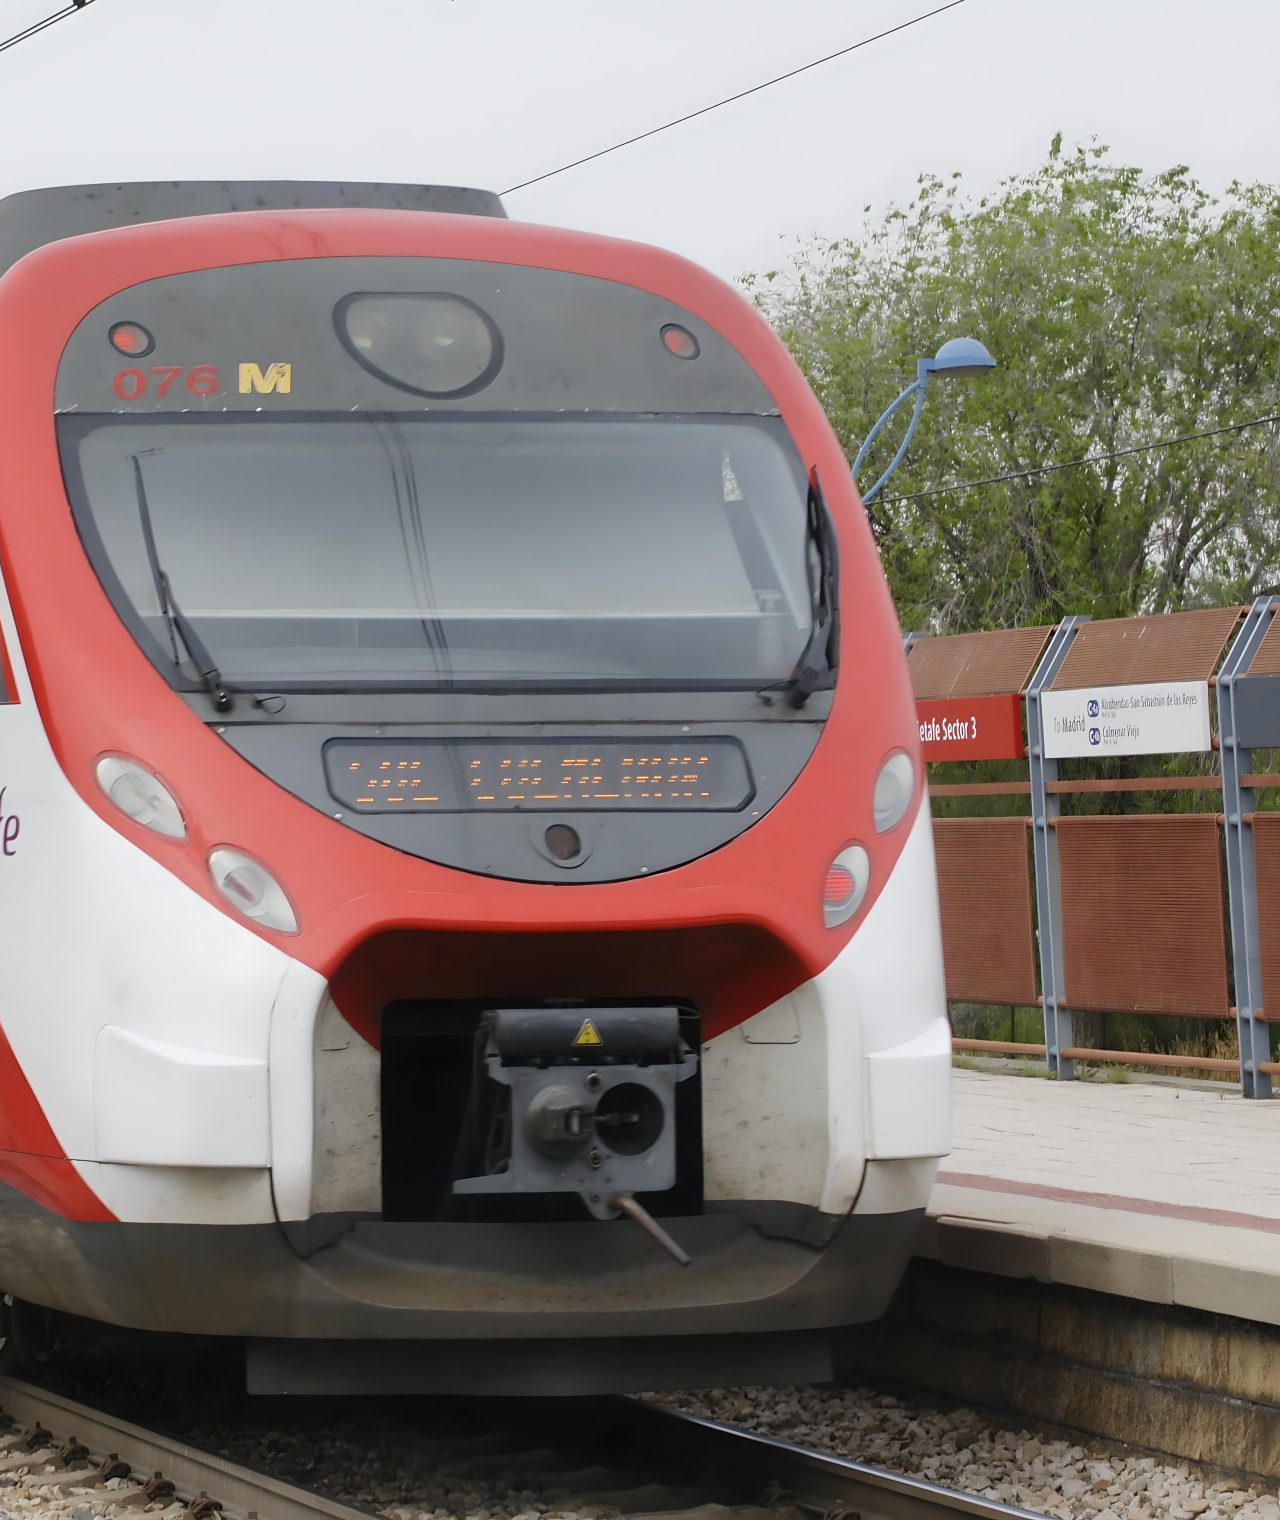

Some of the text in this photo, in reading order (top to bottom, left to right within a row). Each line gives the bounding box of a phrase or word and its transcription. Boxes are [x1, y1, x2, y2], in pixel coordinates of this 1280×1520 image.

[112, 362, 291, 401] 076 M
[916, 716, 977, 742] etafe Sector 3
[1062, 714, 1086, 733] Madrid
